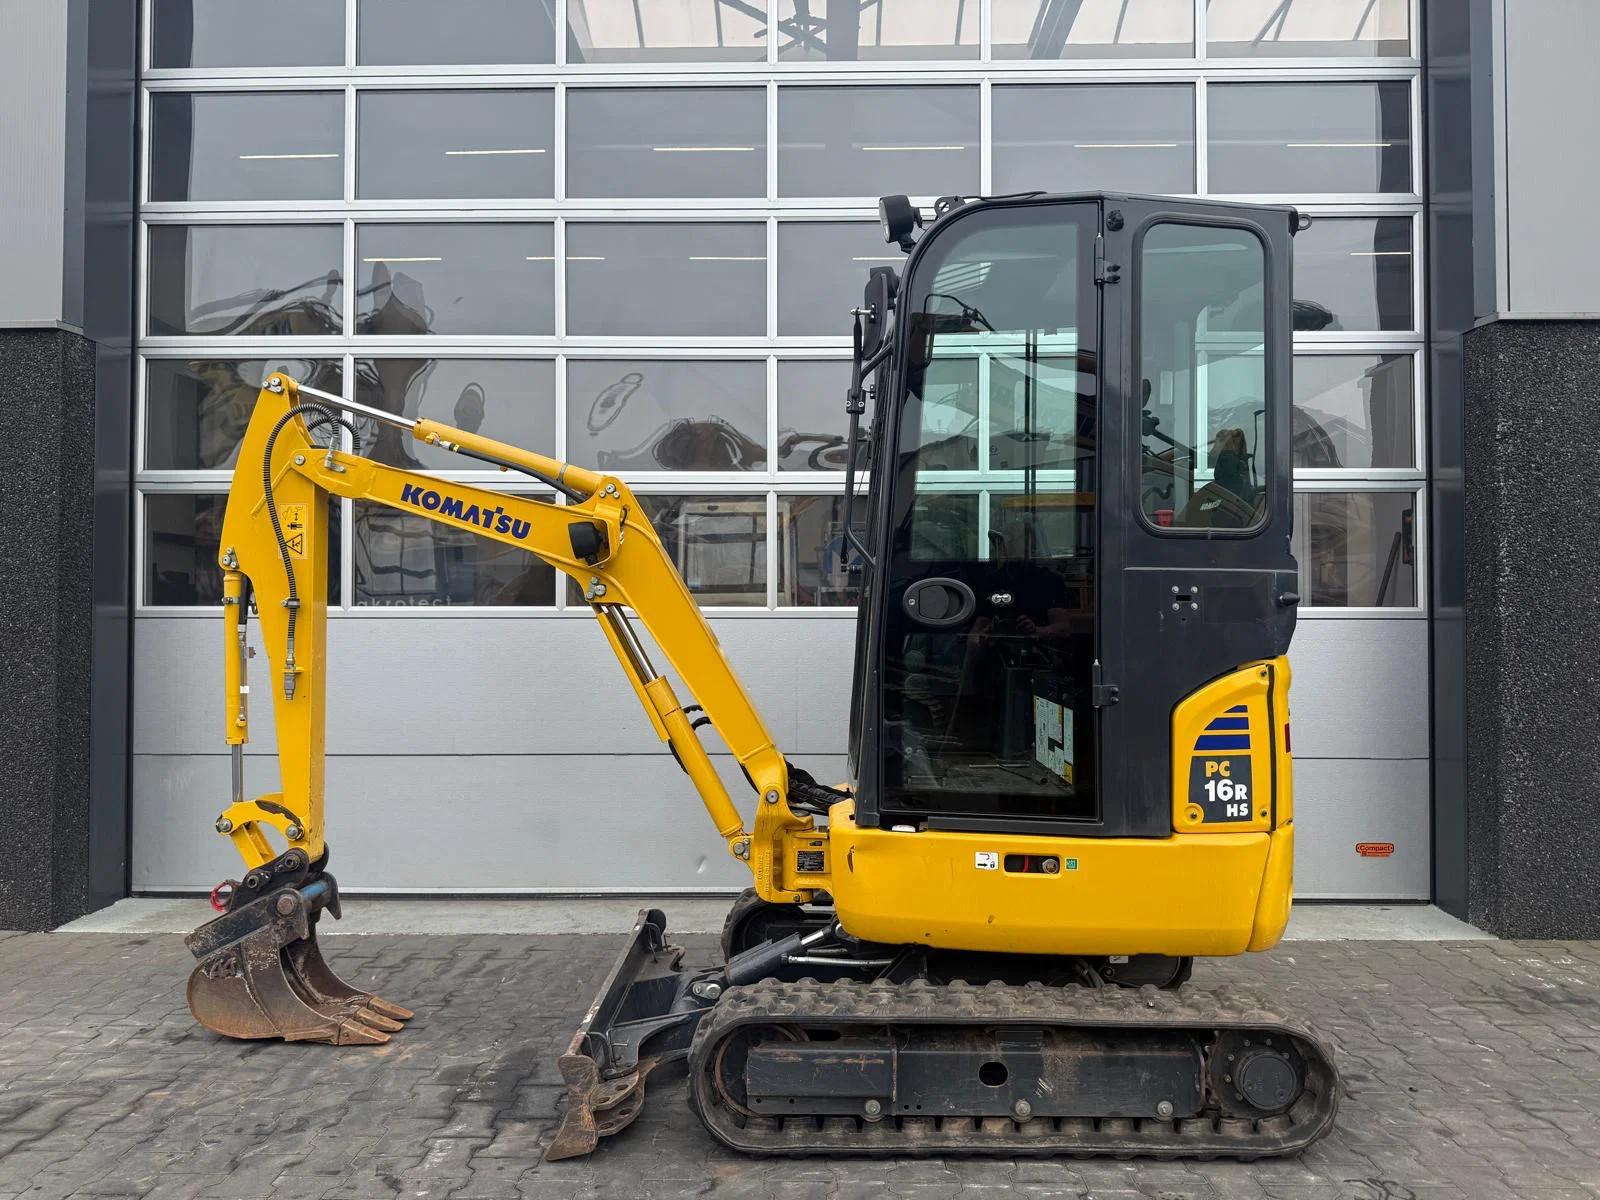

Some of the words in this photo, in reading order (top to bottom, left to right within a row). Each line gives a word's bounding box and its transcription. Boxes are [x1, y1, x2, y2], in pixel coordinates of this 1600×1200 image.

[400, 483, 532, 539] KOMATSU
[1205, 760, 1231, 777] PC
[1204, 779, 1248, 802] 16R
[1226, 803, 1249, 817] HS
